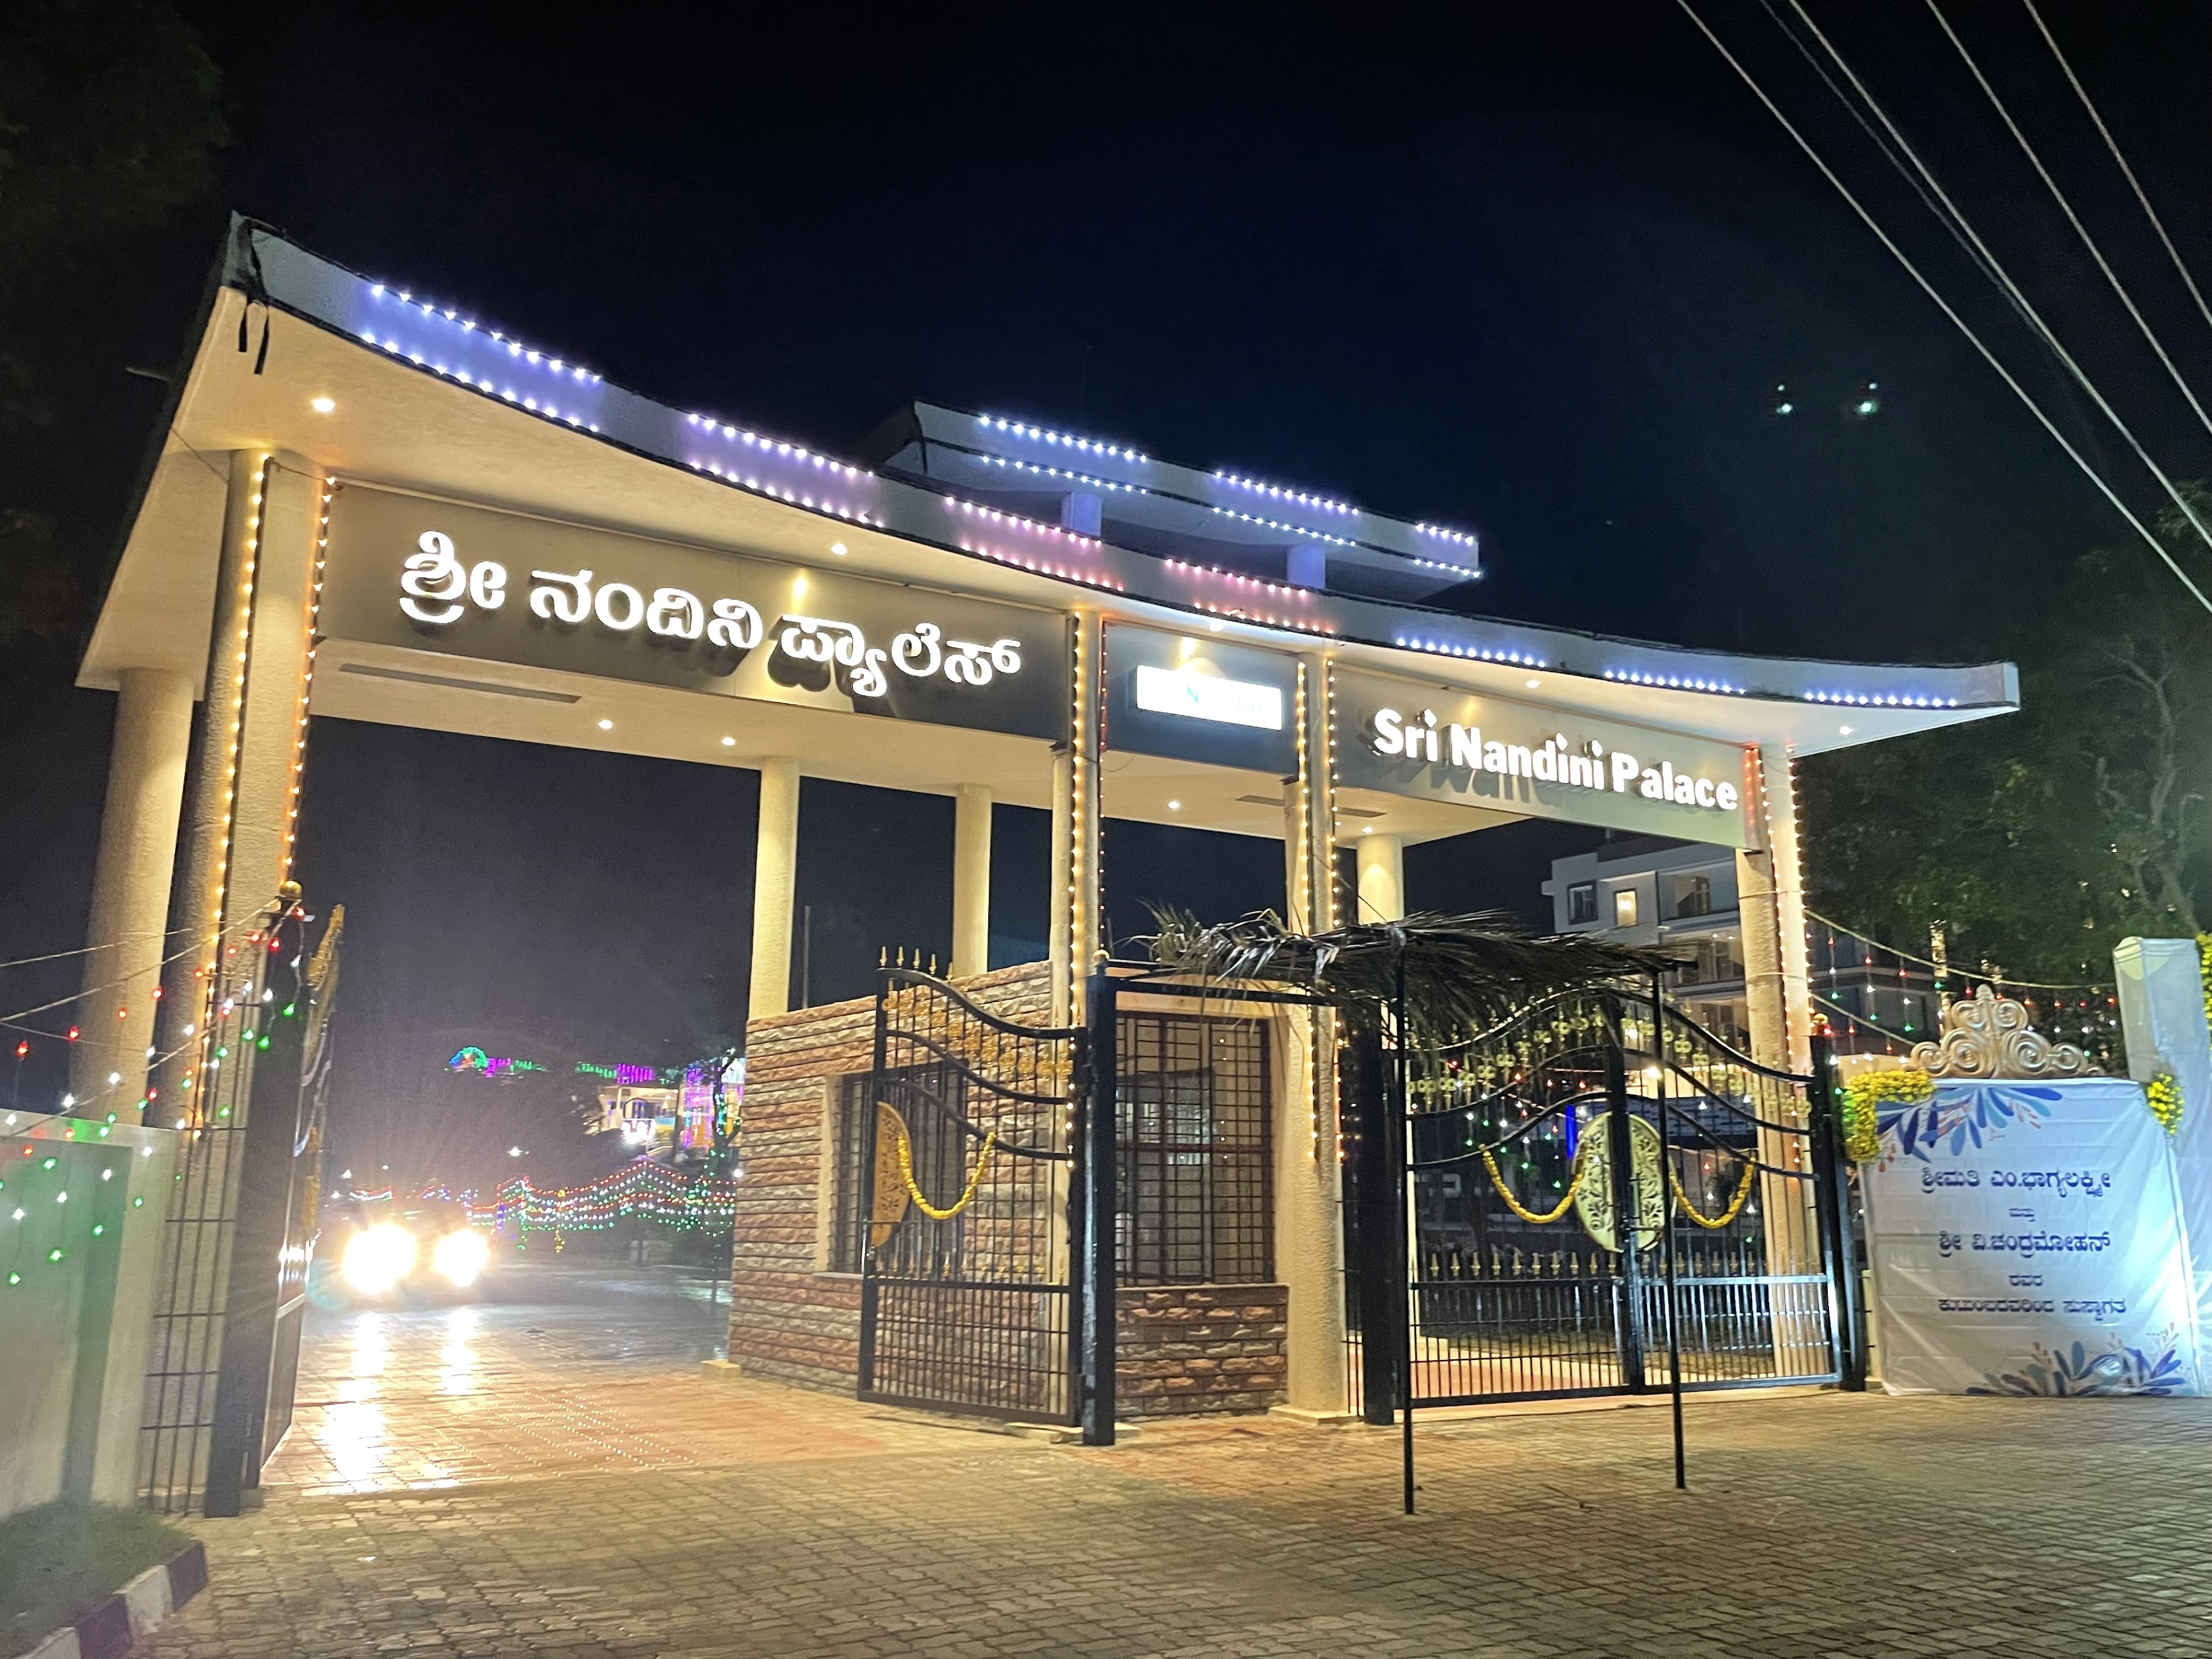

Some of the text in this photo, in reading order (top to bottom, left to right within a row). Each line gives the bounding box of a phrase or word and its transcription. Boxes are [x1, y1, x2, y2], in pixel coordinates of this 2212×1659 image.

[399, 530, 1022, 698] ಶ್ರೀ ನಂದಿನಿ ಪ್ಯಾಲೆಸ್
[1374, 707, 1738, 812] Sri Nandini Palace
[1922, 1167, 1980, 1194] ಶ್ರೀಮತಿ
[1939, 1230, 1962, 1257] ಶ್ರೀ
